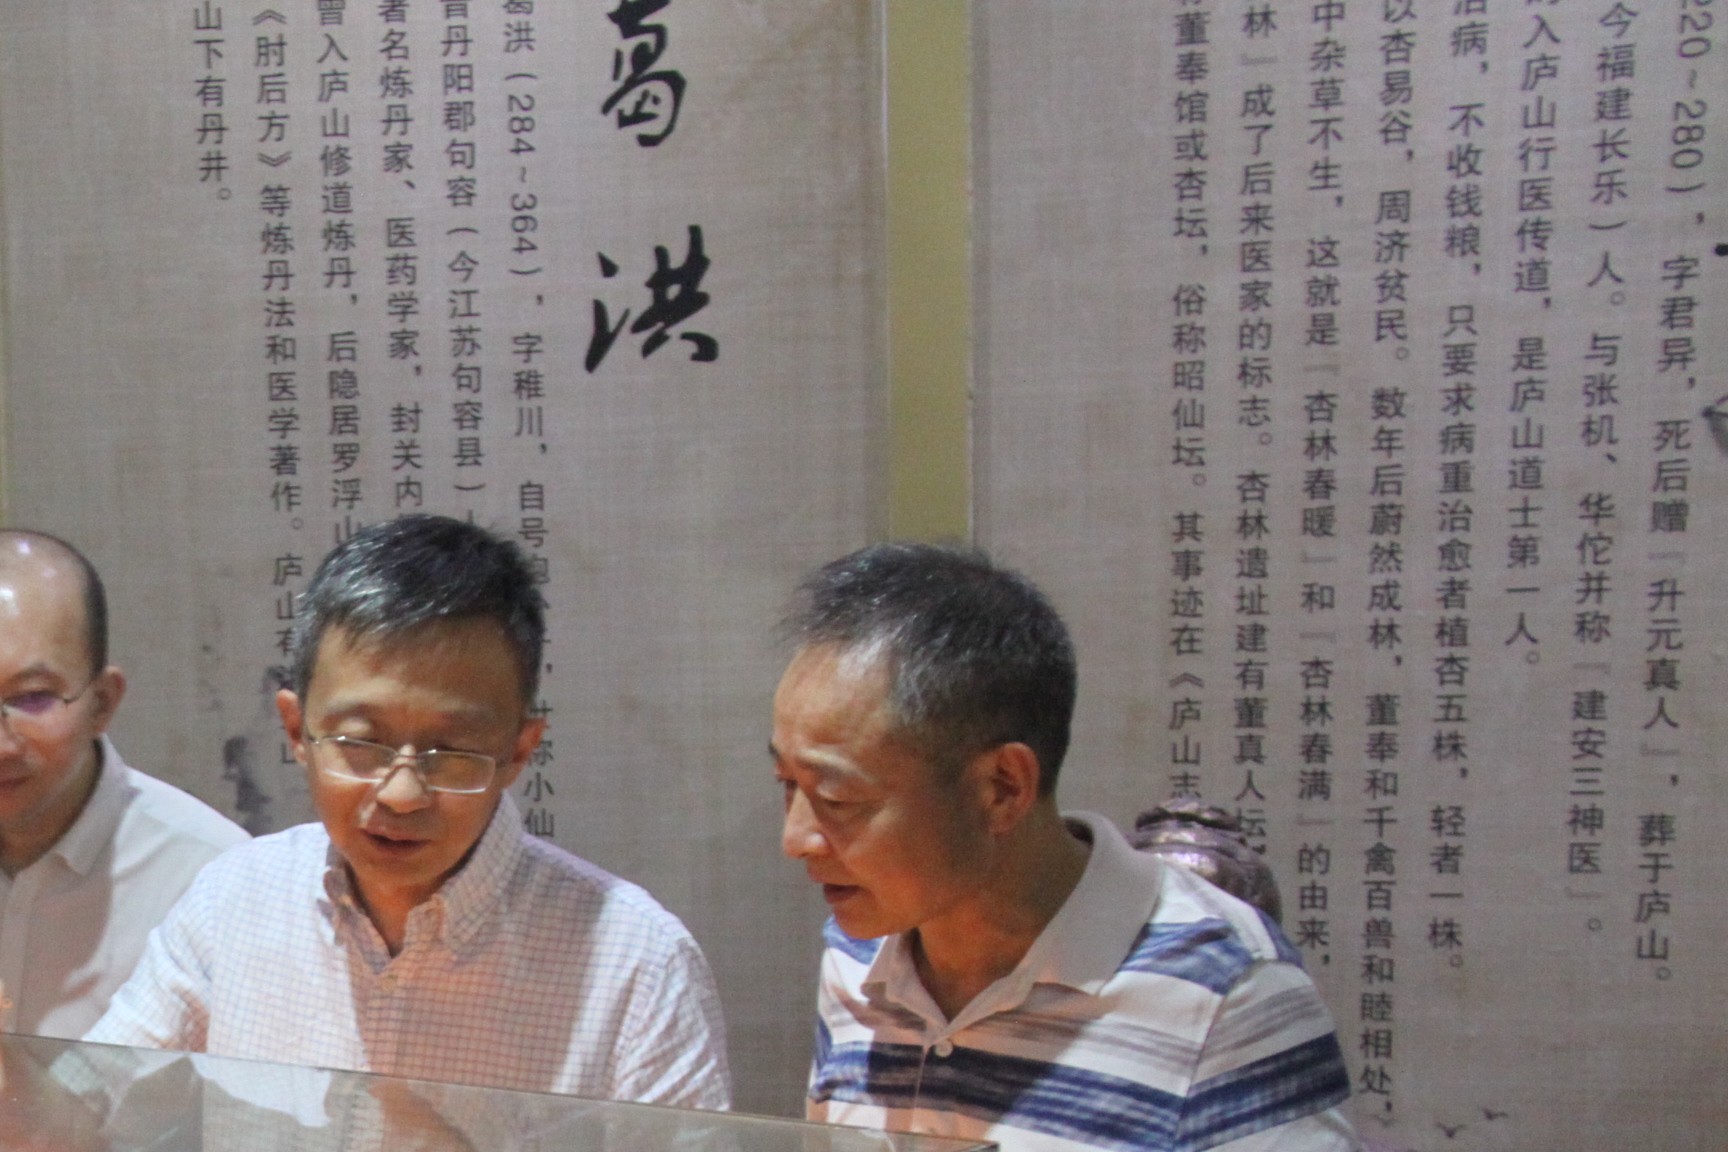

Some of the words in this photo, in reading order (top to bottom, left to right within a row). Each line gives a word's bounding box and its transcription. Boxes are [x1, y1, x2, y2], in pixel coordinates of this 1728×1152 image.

[192, 1, 232, 202] 山下有丹井。
[584, 0, 720, 374] 葛洪
[1504, 0, 1561, 664] 入庐山行医传道，是庐山道士第一人。
